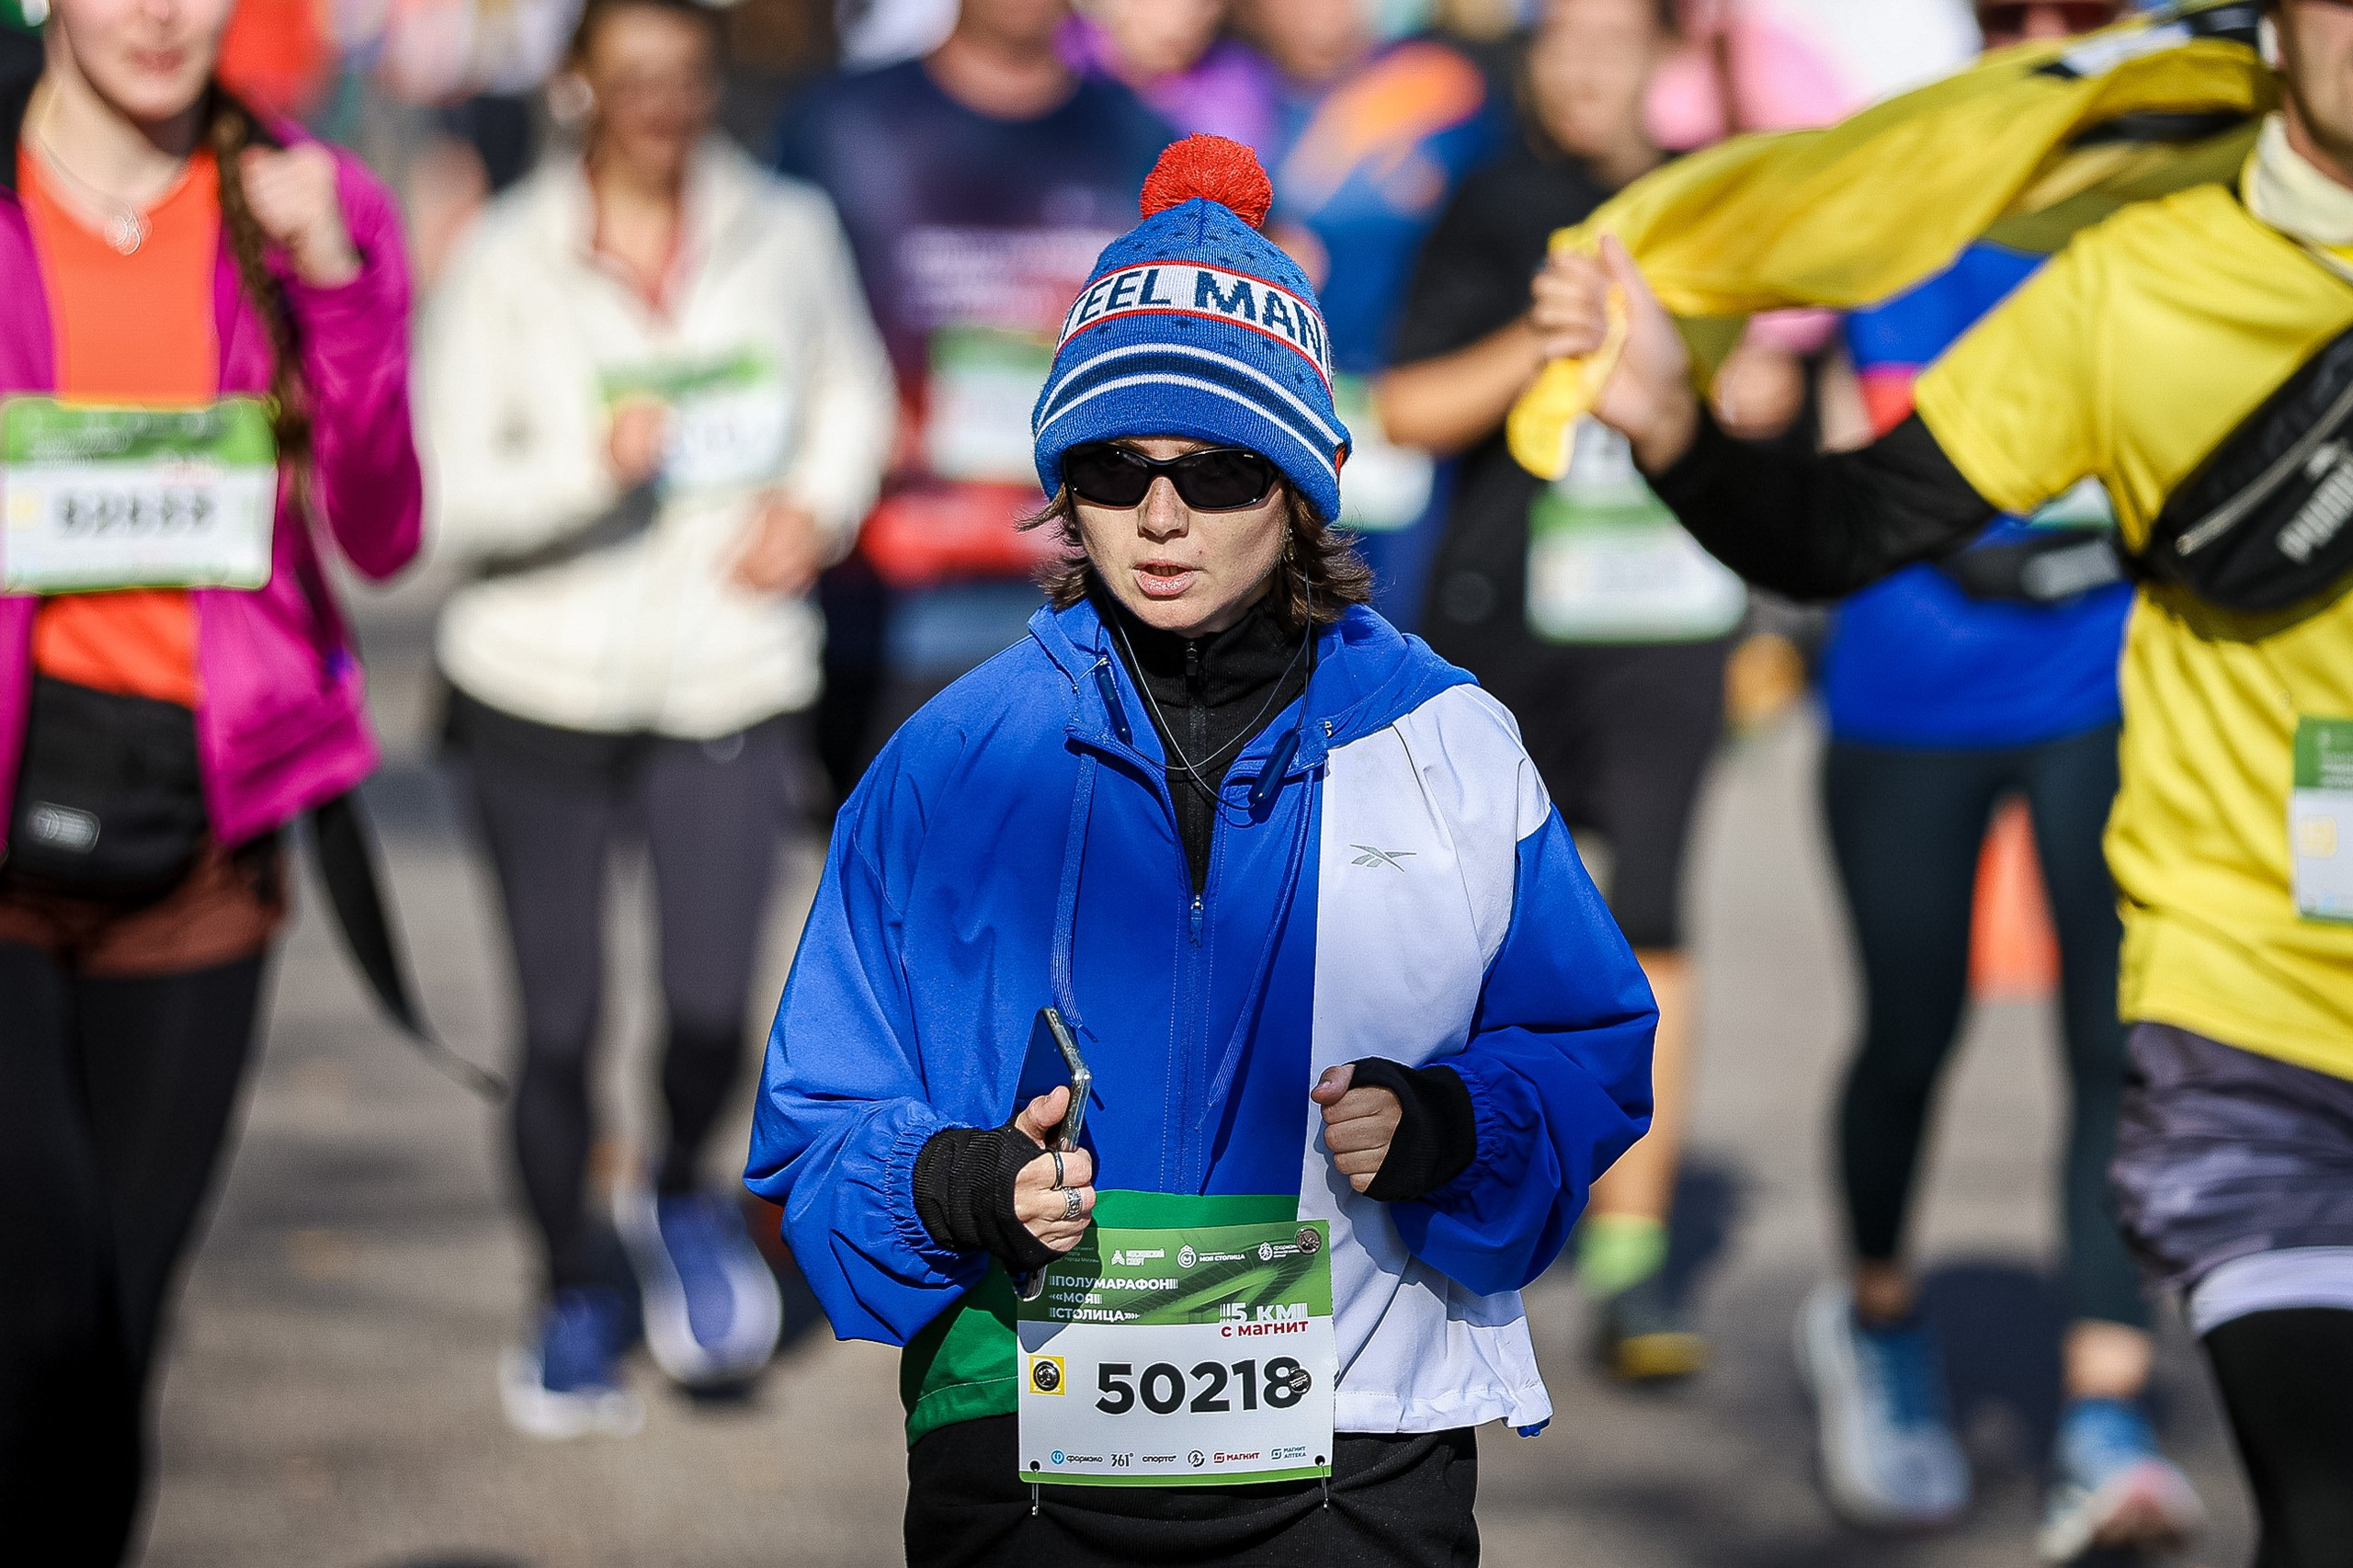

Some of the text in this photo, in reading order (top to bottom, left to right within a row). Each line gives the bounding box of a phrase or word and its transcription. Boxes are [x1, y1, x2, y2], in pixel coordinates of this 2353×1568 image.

[1056, 269, 1171, 347] TEEL
[1195, 270, 1323, 366] MAN
[1095, 1356, 1303, 1415] 50218
[1227, 1452, 1260, 1460] МАГНИТ
[1283, 1451, 1306, 1460] АПТЕКА
